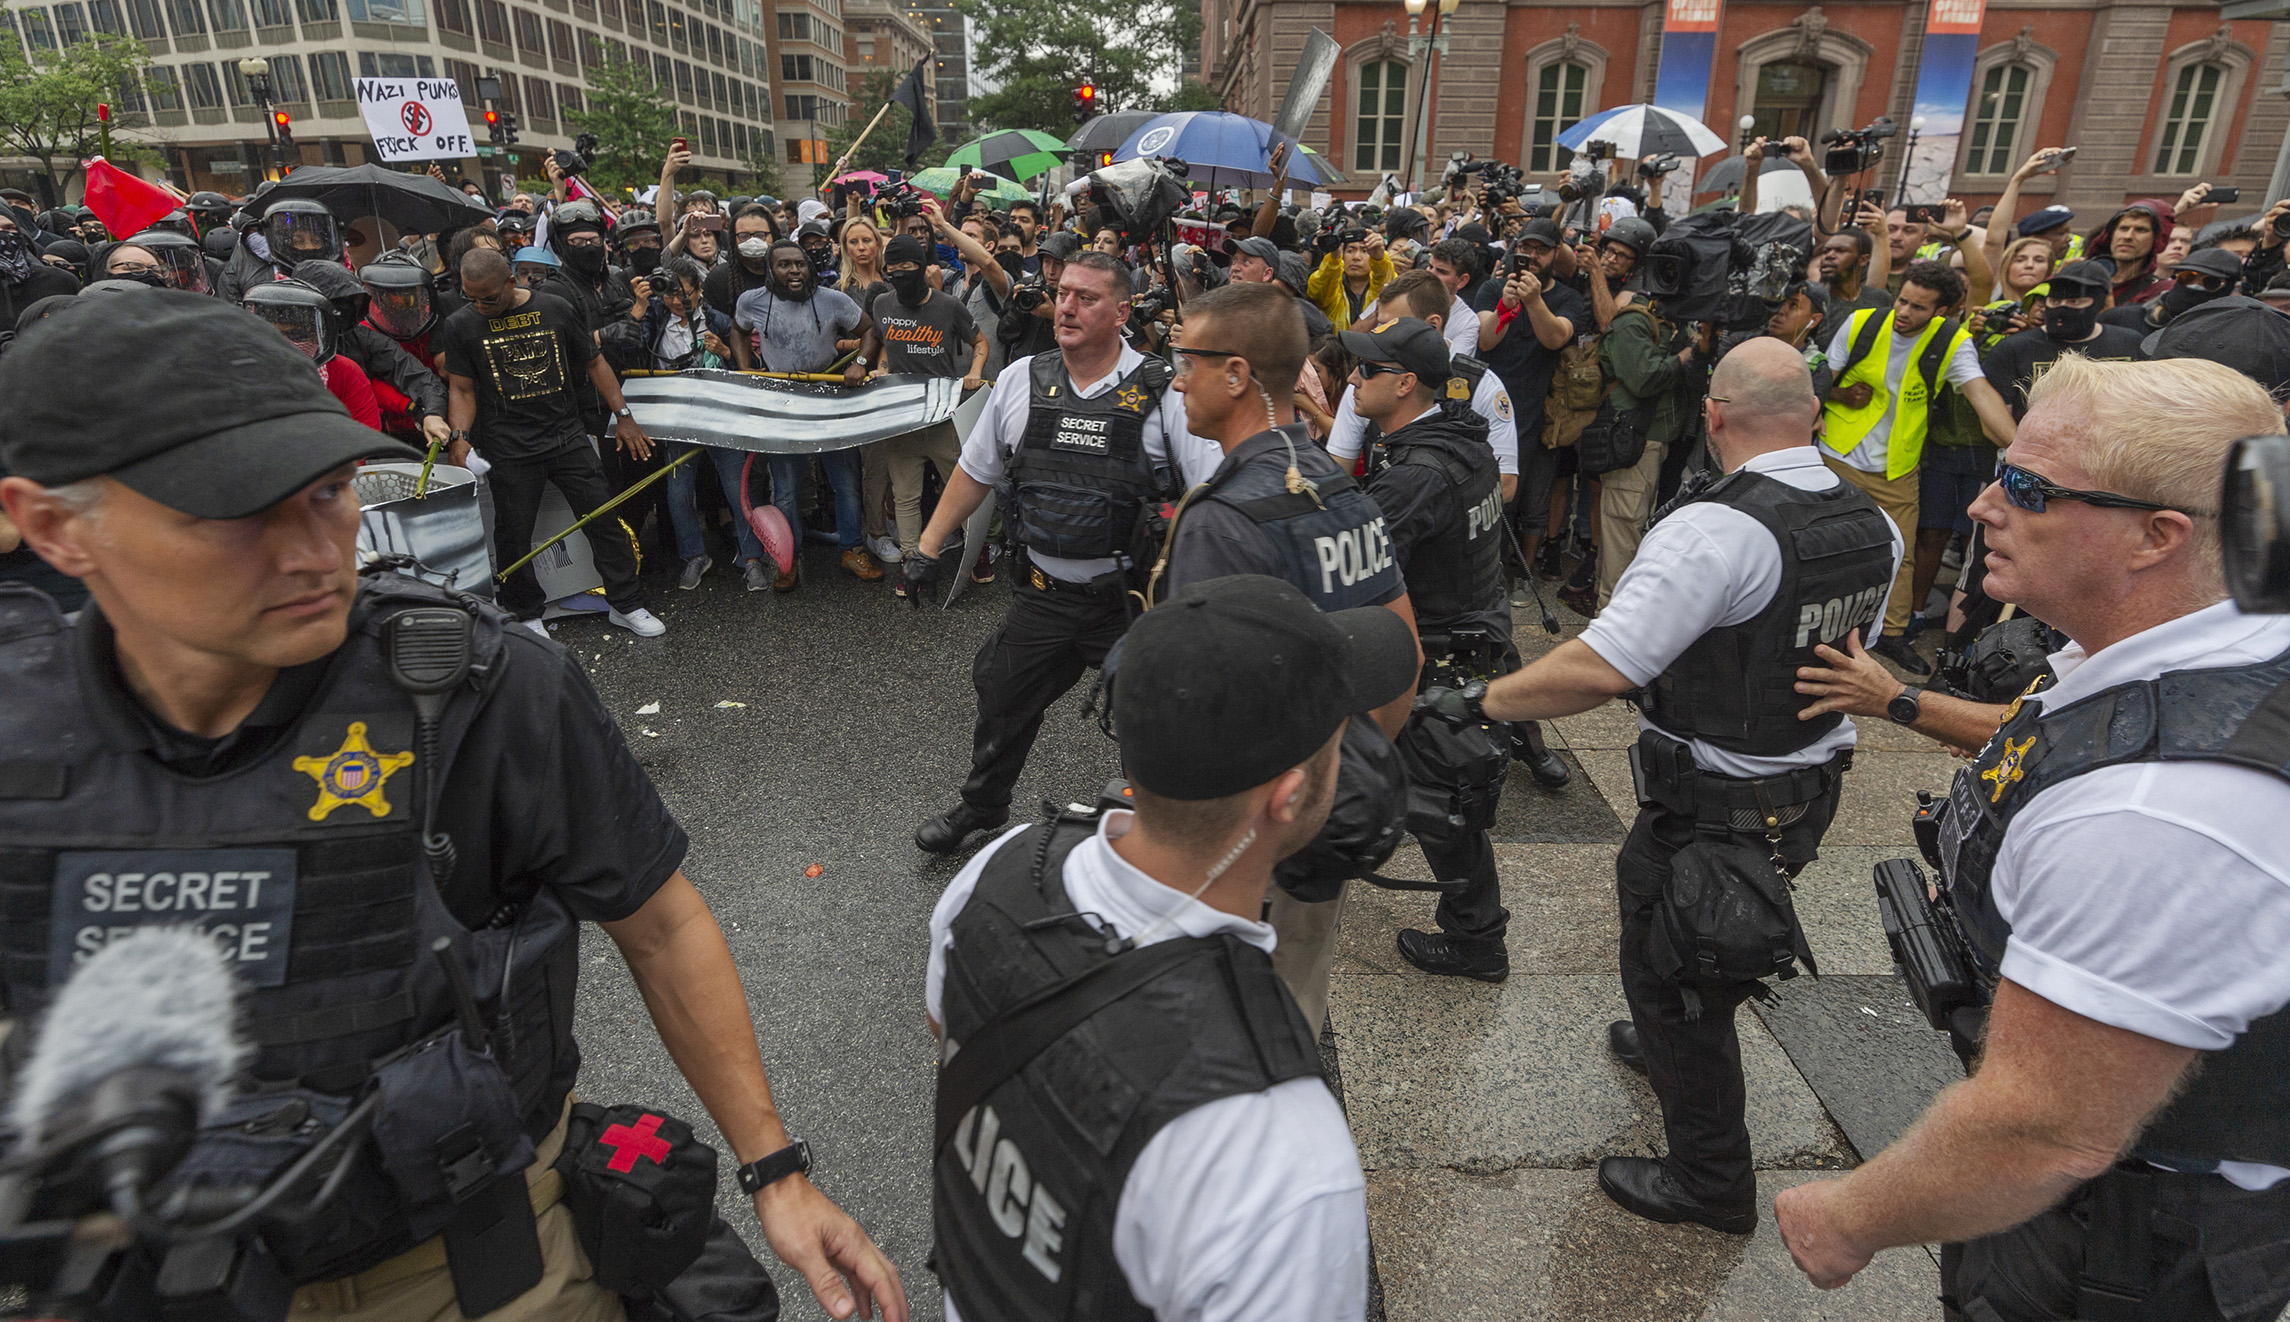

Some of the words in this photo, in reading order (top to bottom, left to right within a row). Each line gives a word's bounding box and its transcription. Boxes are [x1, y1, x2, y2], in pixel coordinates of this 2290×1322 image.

[357, 79, 405, 103] NAZI
[417, 80, 459, 101] PUNKS
[488, 311, 541, 333] DEBT
[885, 324, 944, 348] healthy
[500, 339, 548, 363] PAID
[1060, 417, 1107, 433] SECRET
[1056, 431, 1107, 448] SERVICE
[1467, 480, 1503, 541] POLI
[1314, 516, 1393, 594] POLICE
[1795, 582, 1889, 649] POLICE
[82, 871, 272, 913] SECRET
[942, 1037, 1067, 1284] LICE
